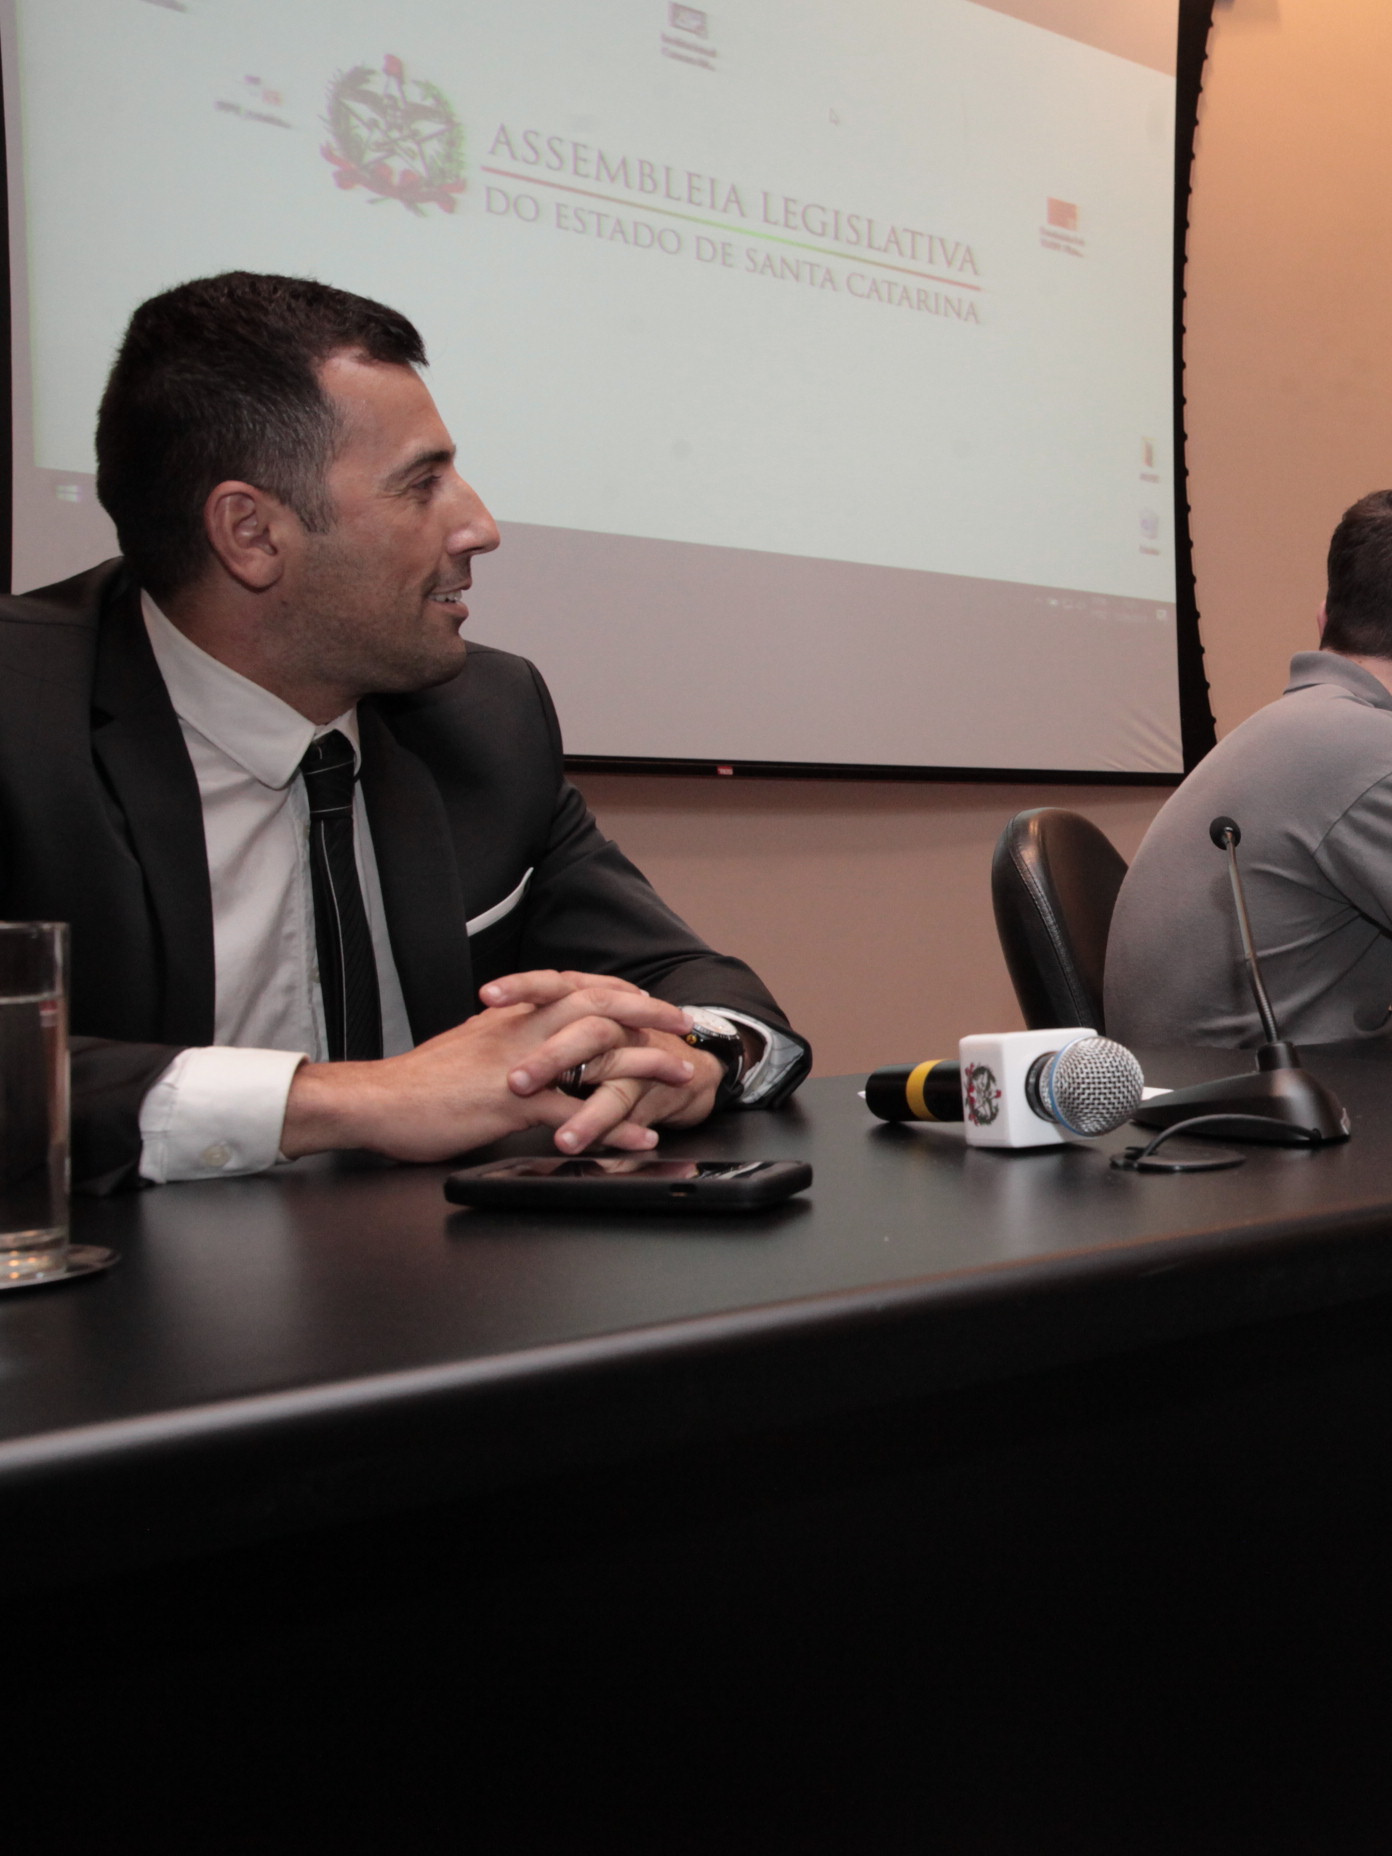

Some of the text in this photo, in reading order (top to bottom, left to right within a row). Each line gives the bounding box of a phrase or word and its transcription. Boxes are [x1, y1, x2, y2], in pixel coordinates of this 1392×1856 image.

[484, 185, 981, 325] DO ESTADO DE SANTA CATARINA
[488, 122, 980, 276] ASSEMBLEIA LEGISLATIVA
